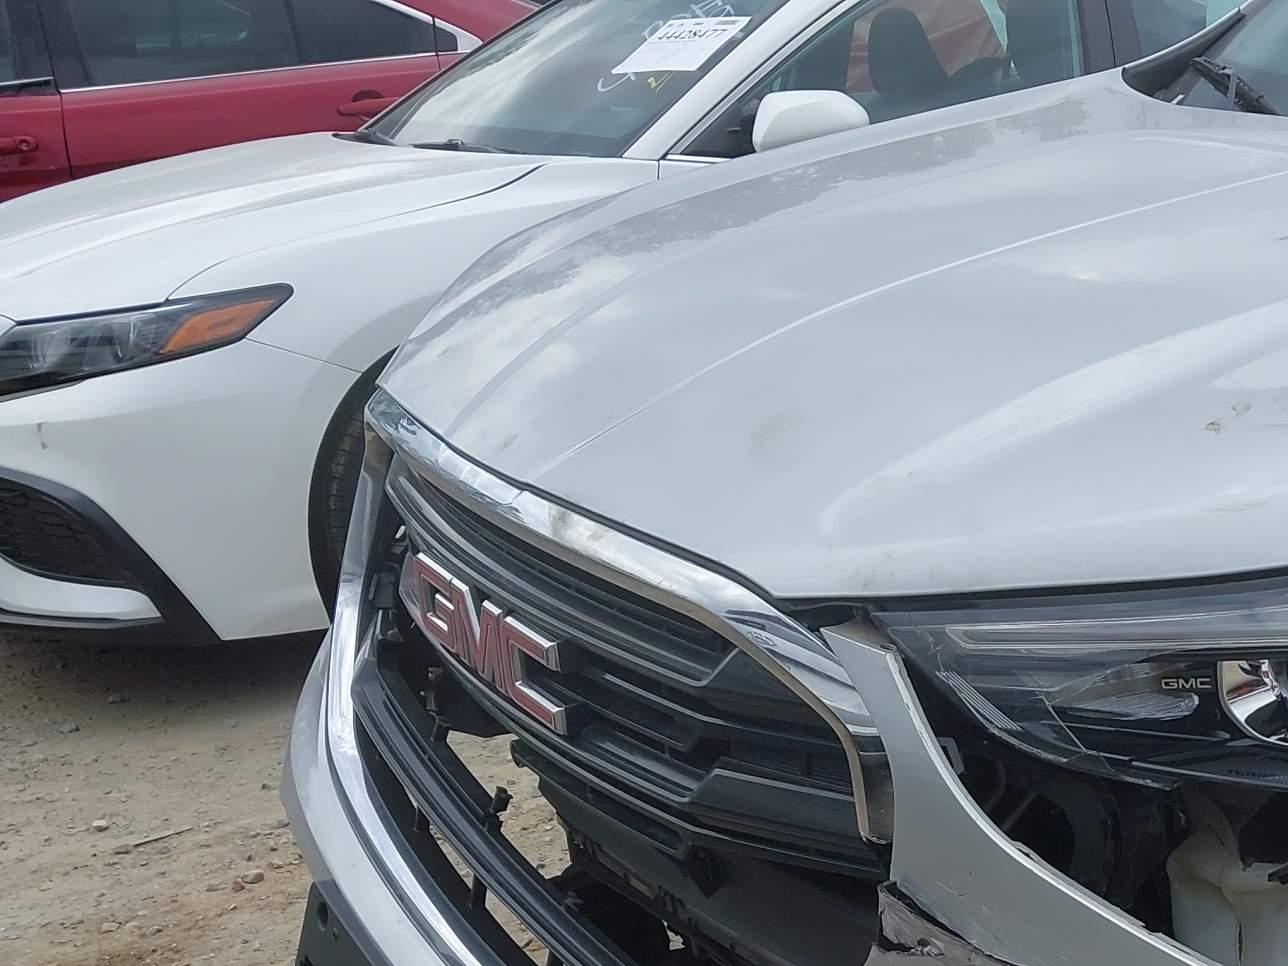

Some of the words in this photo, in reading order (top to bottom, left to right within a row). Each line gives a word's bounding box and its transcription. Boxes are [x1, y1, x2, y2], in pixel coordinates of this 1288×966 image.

[658, 28, 728, 41] 44428477
[402, 552, 568, 735] GMC
[1161, 677, 1212, 690] GMC
